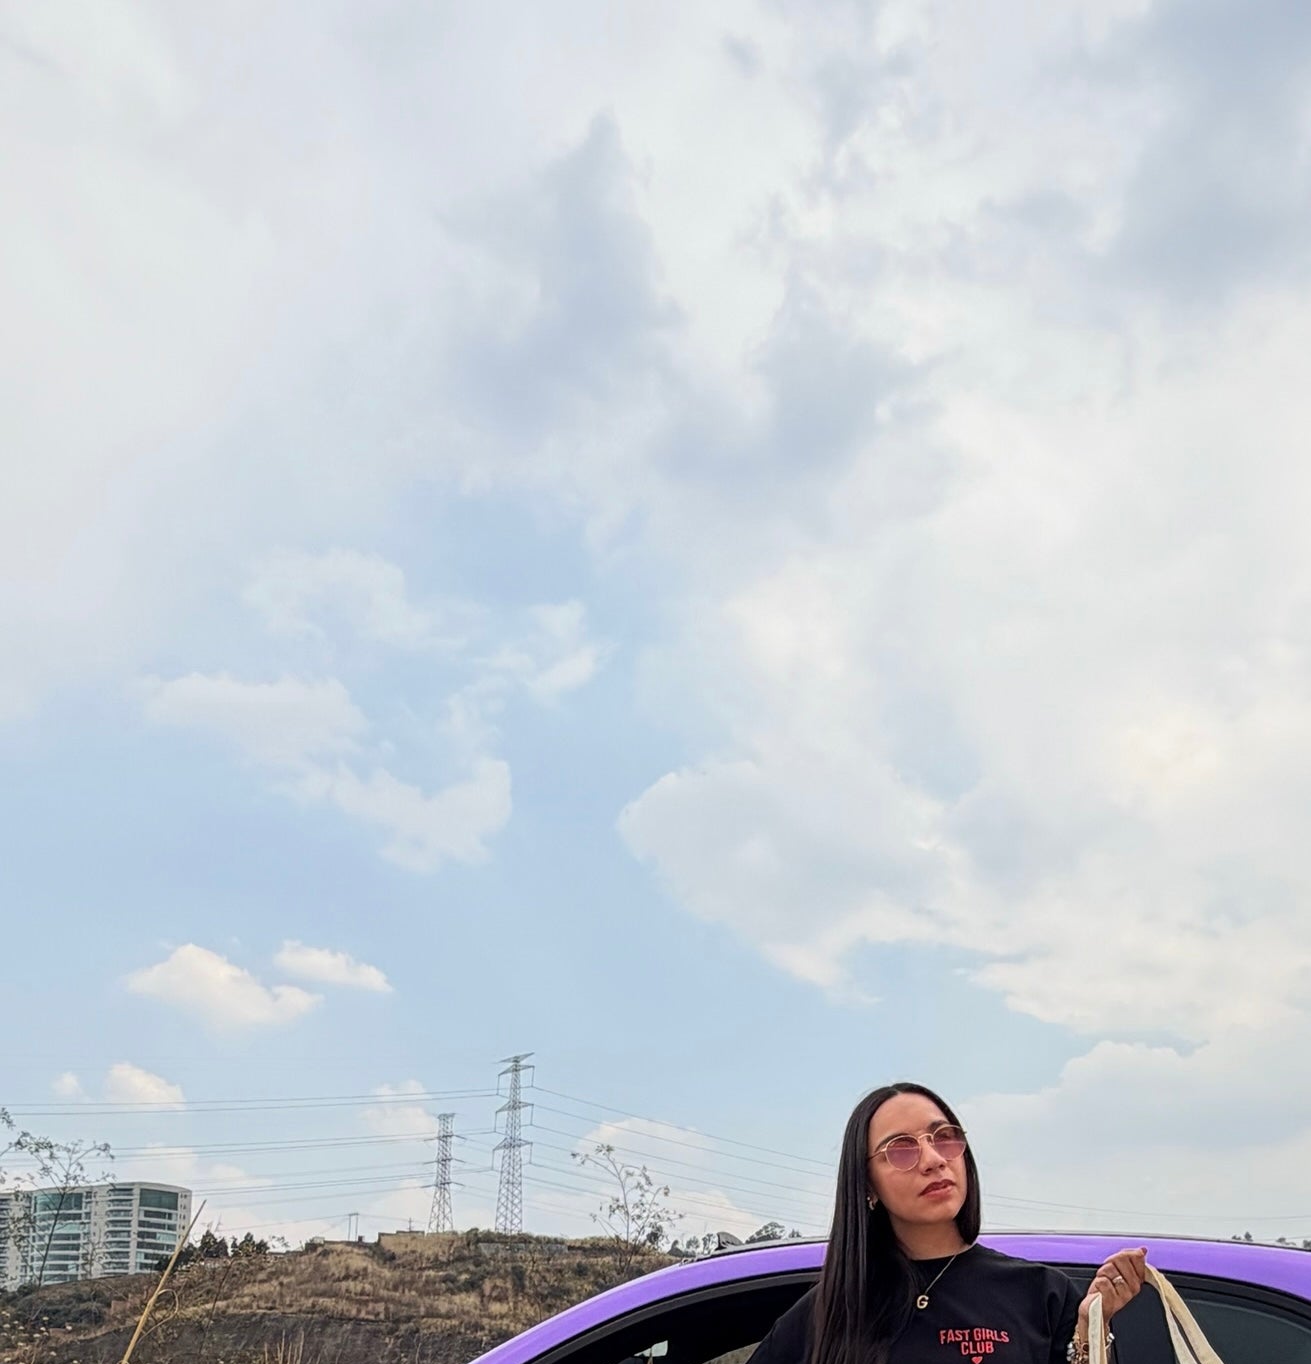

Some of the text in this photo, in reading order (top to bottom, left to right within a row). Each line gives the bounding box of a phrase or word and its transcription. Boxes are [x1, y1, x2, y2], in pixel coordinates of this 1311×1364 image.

[939, 1327, 1010, 1345] FAST GIRLS
[960, 1341, 995, 1356] CLUB
